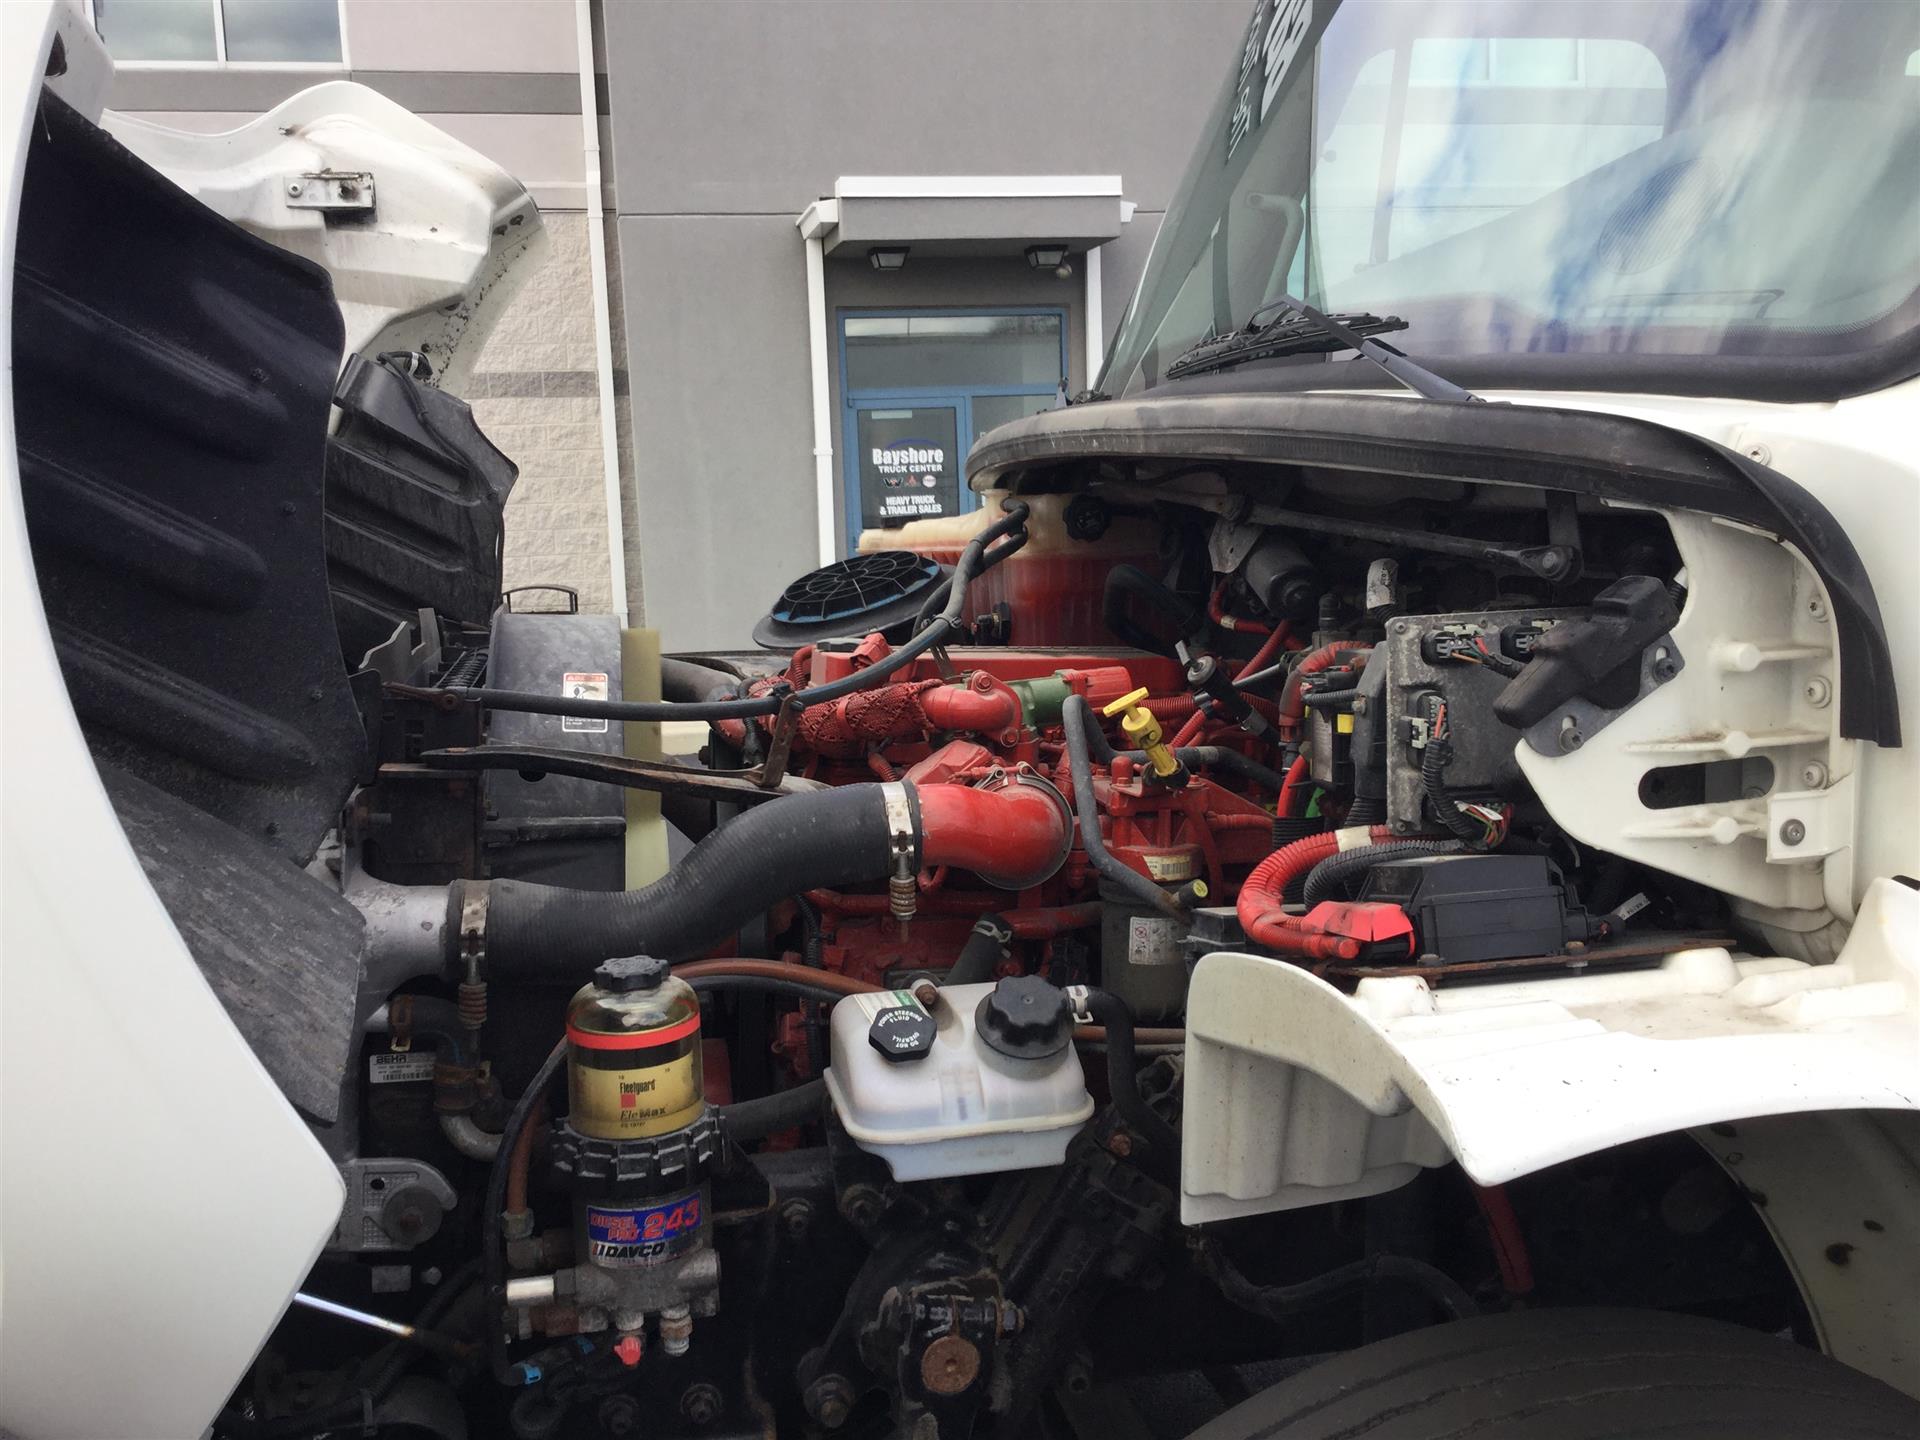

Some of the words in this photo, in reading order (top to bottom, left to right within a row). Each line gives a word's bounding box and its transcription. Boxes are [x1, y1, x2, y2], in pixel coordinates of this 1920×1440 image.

[872, 446, 944, 465] Bayshore
[878, 465, 908, 473] TRUCK
[909, 464, 943, 472] CENTER
[885, 496, 910, 505] HEAVY
[911, 495, 935, 504] TRUCK
[879, 506, 887, 515] &
[887, 505, 918, 514] TRAILER
[918, 504, 942, 513] SALES
[889, 1015, 910, 1023] FLUID
[619, 1079, 656, 1095] Fleetguard
[590, 1213, 637, 1228] DIESEL
[608, 1226, 639, 1241] PRO
[643, 1199, 699, 1240] 243
[605, 1242, 665, 1258] DAVCO
